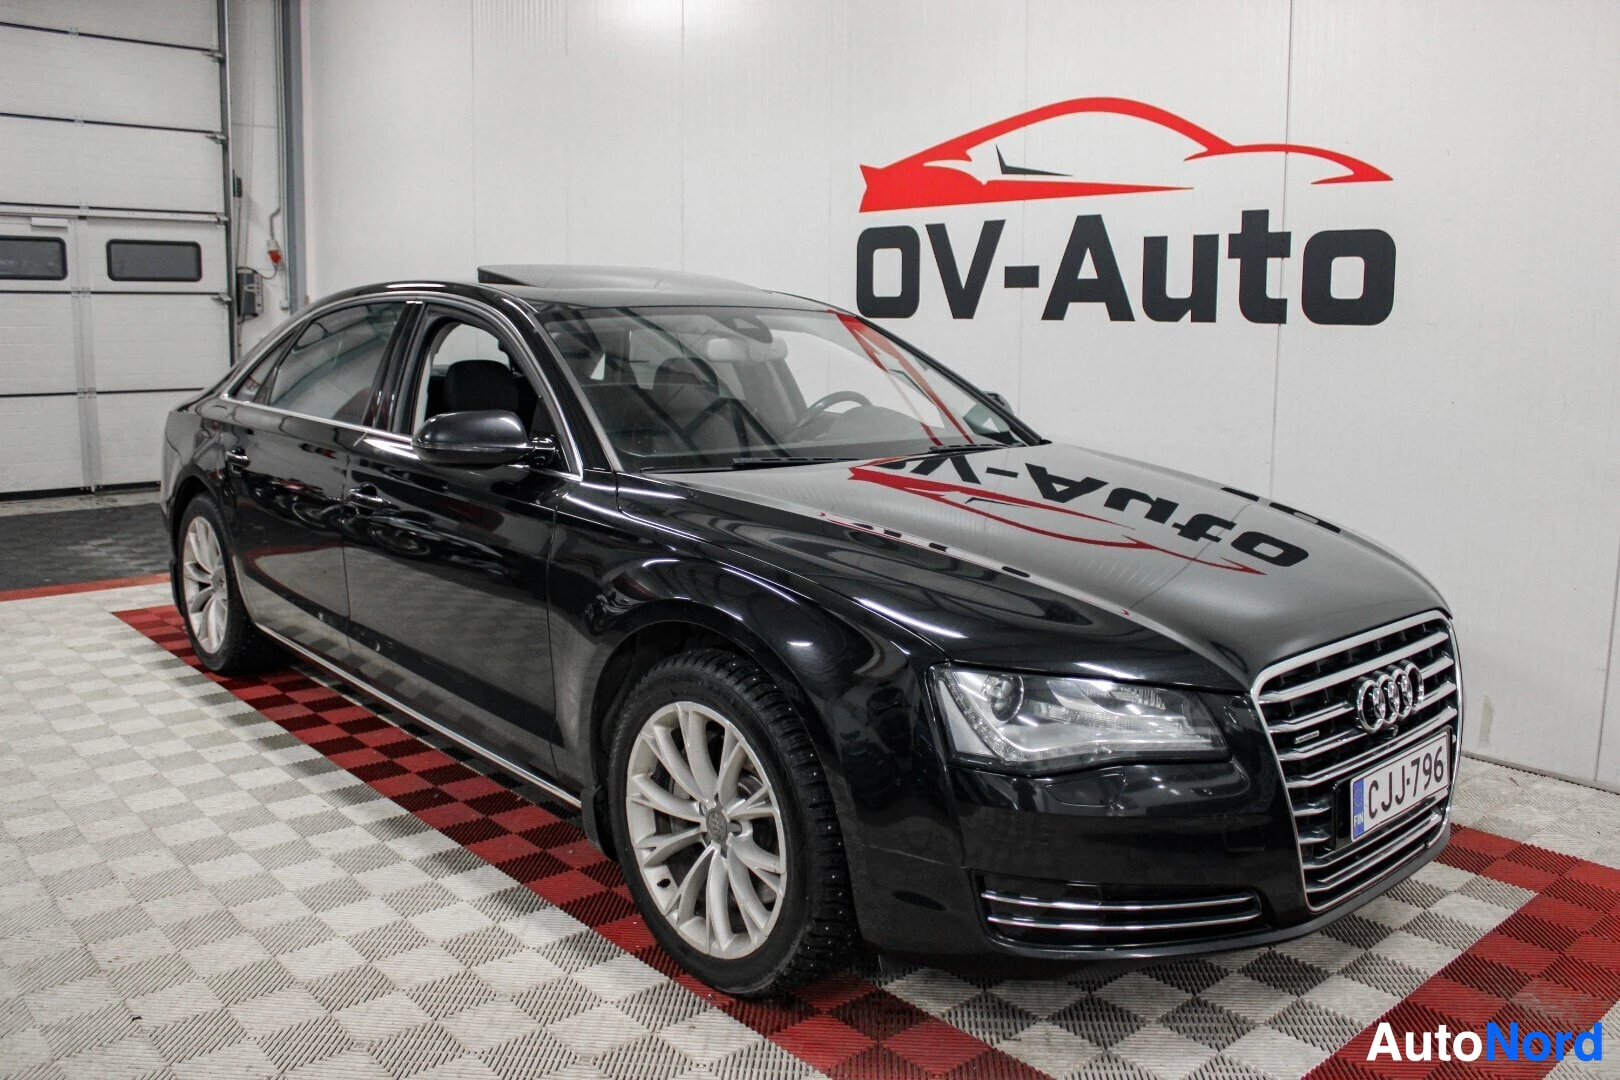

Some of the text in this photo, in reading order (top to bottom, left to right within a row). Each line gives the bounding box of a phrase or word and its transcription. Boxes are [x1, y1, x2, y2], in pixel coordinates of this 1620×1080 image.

[856, 209, 1396, 326] OV-Auto
[1368, 745, 1444, 819] CJJ-796
[1354, 812, 1364, 827] FIN
